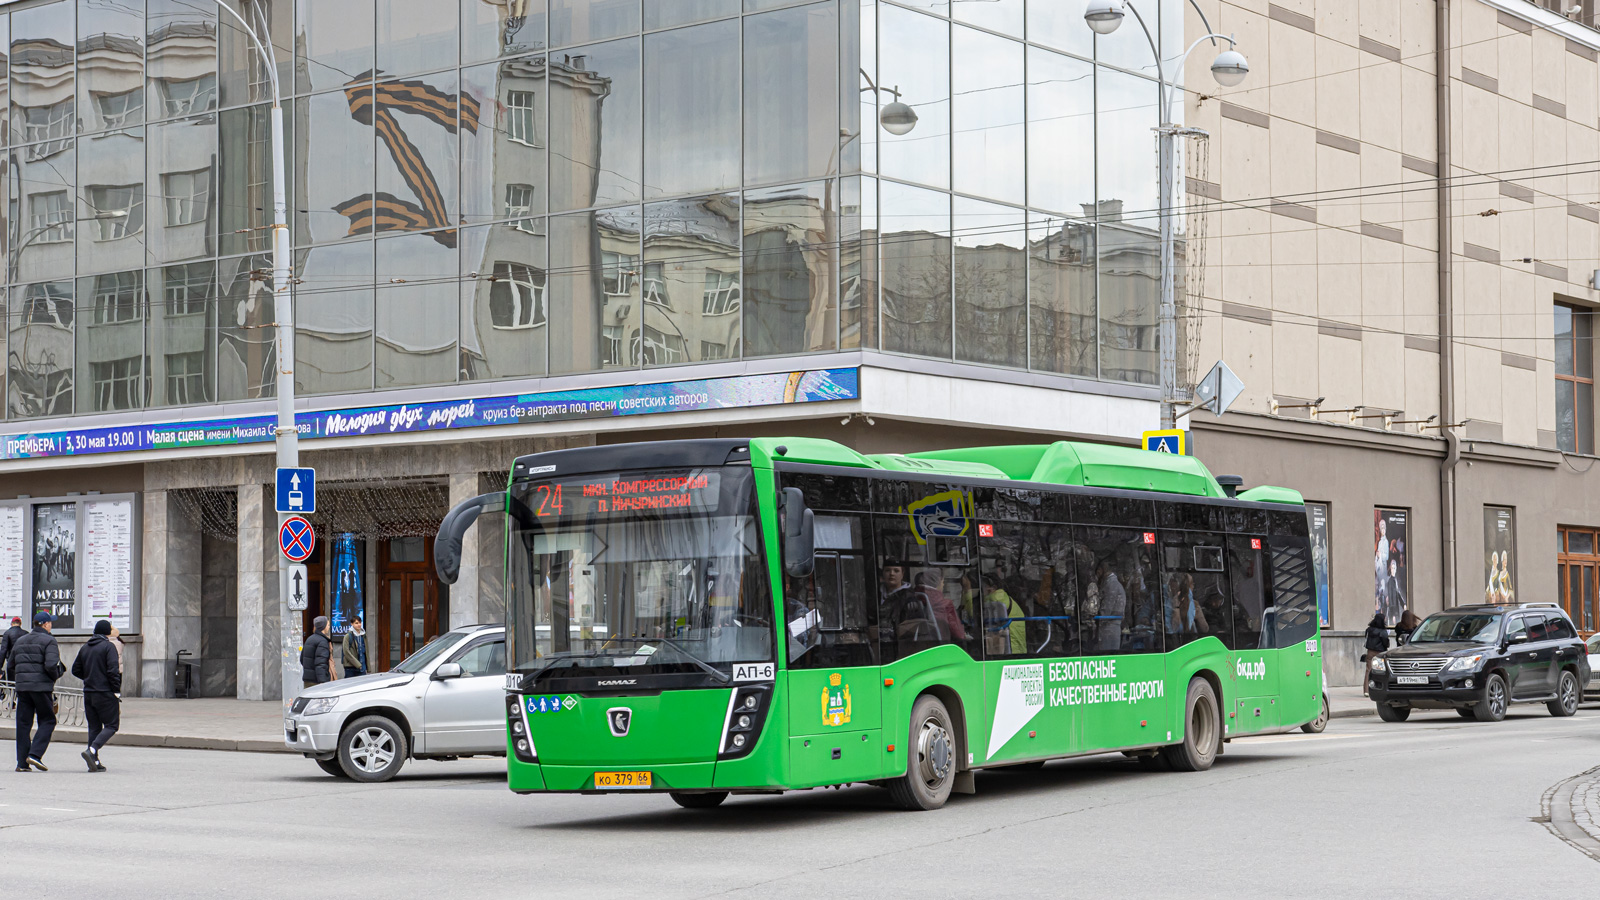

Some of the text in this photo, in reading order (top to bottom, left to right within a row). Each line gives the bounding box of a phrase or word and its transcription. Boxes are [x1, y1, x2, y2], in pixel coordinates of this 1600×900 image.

[483, 393, 709, 422] круиз без антракта под песни советских авторов
[325, 399, 475, 436] Мелодия двух морей
[76, 435, 87, 449] 30
[88, 437, 105, 448] мая
[108, 431, 134, 447] 19.00
[147, 429, 176, 444] Малая
[178, 430, 204, 443] сцена
[207, 430, 231, 440] имени
[232, 426, 266, 438] Михаила
[8, 438, 55, 454] ПРЕМЬЕРА
[537, 484, 563, 516] 24
[612, 493, 691, 511] Мичуринский
[736, 666, 772, 678] АП-6
[1004, 666, 1042, 680] НАЦИОНАЛЬНЫЕ
[1049, 660, 1117, 682] БЕЗОПАСНЫЕ
[1237, 657, 1266, 680] бкд.рф
[1020, 680, 1043, 692] ПРОЕКТЫ
[1050, 680, 1164, 707] КАЧЕСТВЕННЫЕ ДОРОГИ
[1025, 693, 1043, 706] РОССИИ
[614, 774, 633, 785] 379
[638, 773, 648, 781] 66
